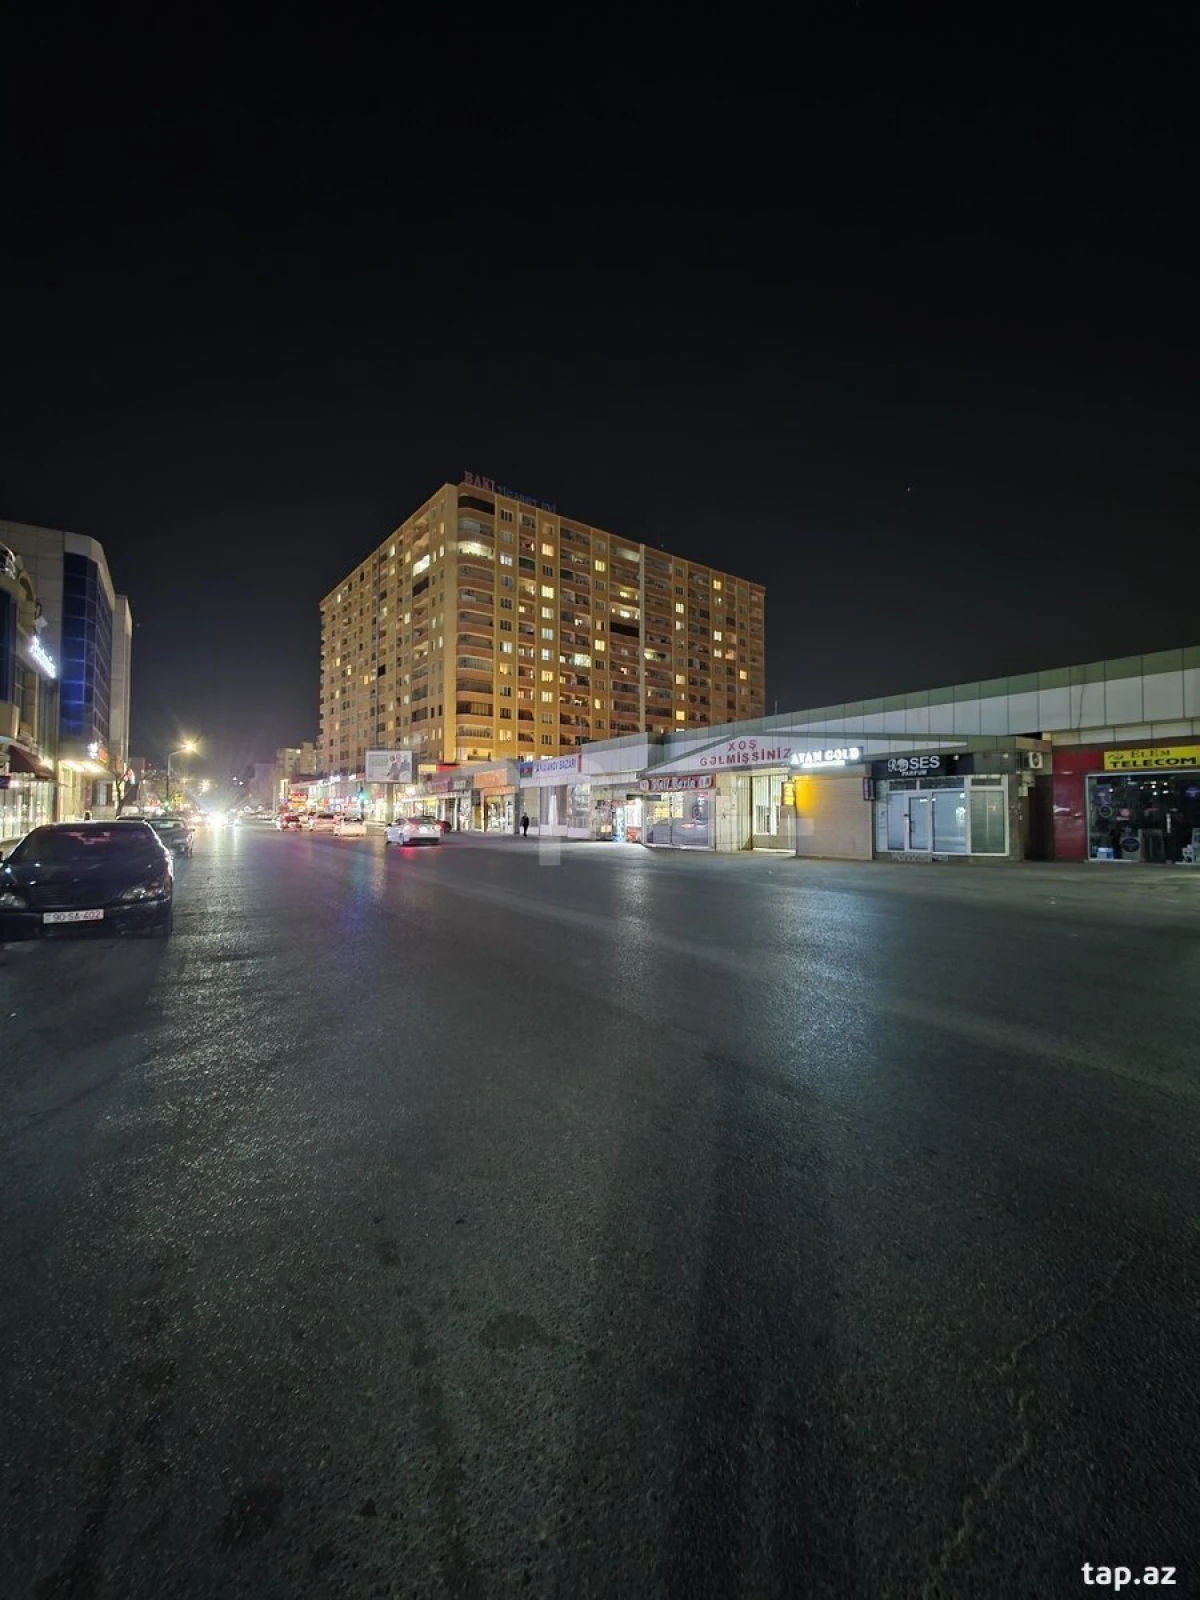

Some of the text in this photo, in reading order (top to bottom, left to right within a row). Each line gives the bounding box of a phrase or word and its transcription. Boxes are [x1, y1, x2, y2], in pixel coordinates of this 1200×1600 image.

[727, 739, 757, 751] XOŞ
[700, 746, 791, 766] GƏLMİŞSİNİZ
[1109, 757, 1197, 768] TELECOM
[887, 755, 941, 772] ROSES
